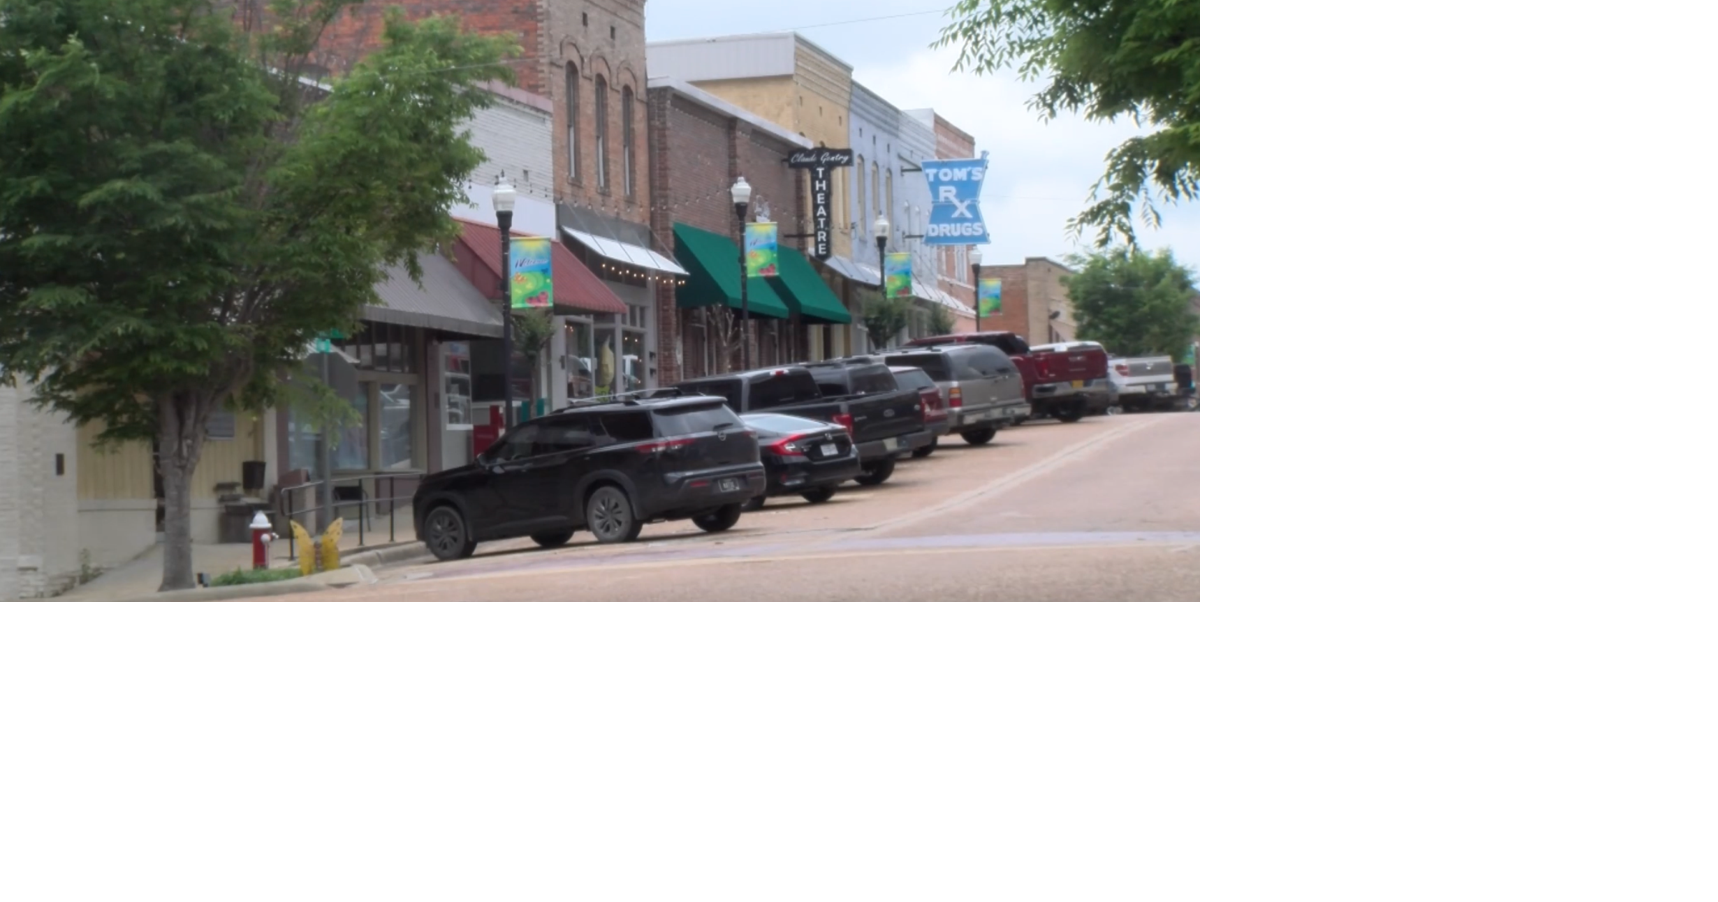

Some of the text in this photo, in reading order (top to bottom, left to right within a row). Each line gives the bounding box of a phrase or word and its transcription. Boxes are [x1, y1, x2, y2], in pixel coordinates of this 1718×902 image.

[820, 151, 849, 164] Gentry
[926, 166, 983, 182] TOM'S
[815, 167, 828, 255] THEATRE
[927, 222, 983, 237] DRUGS
